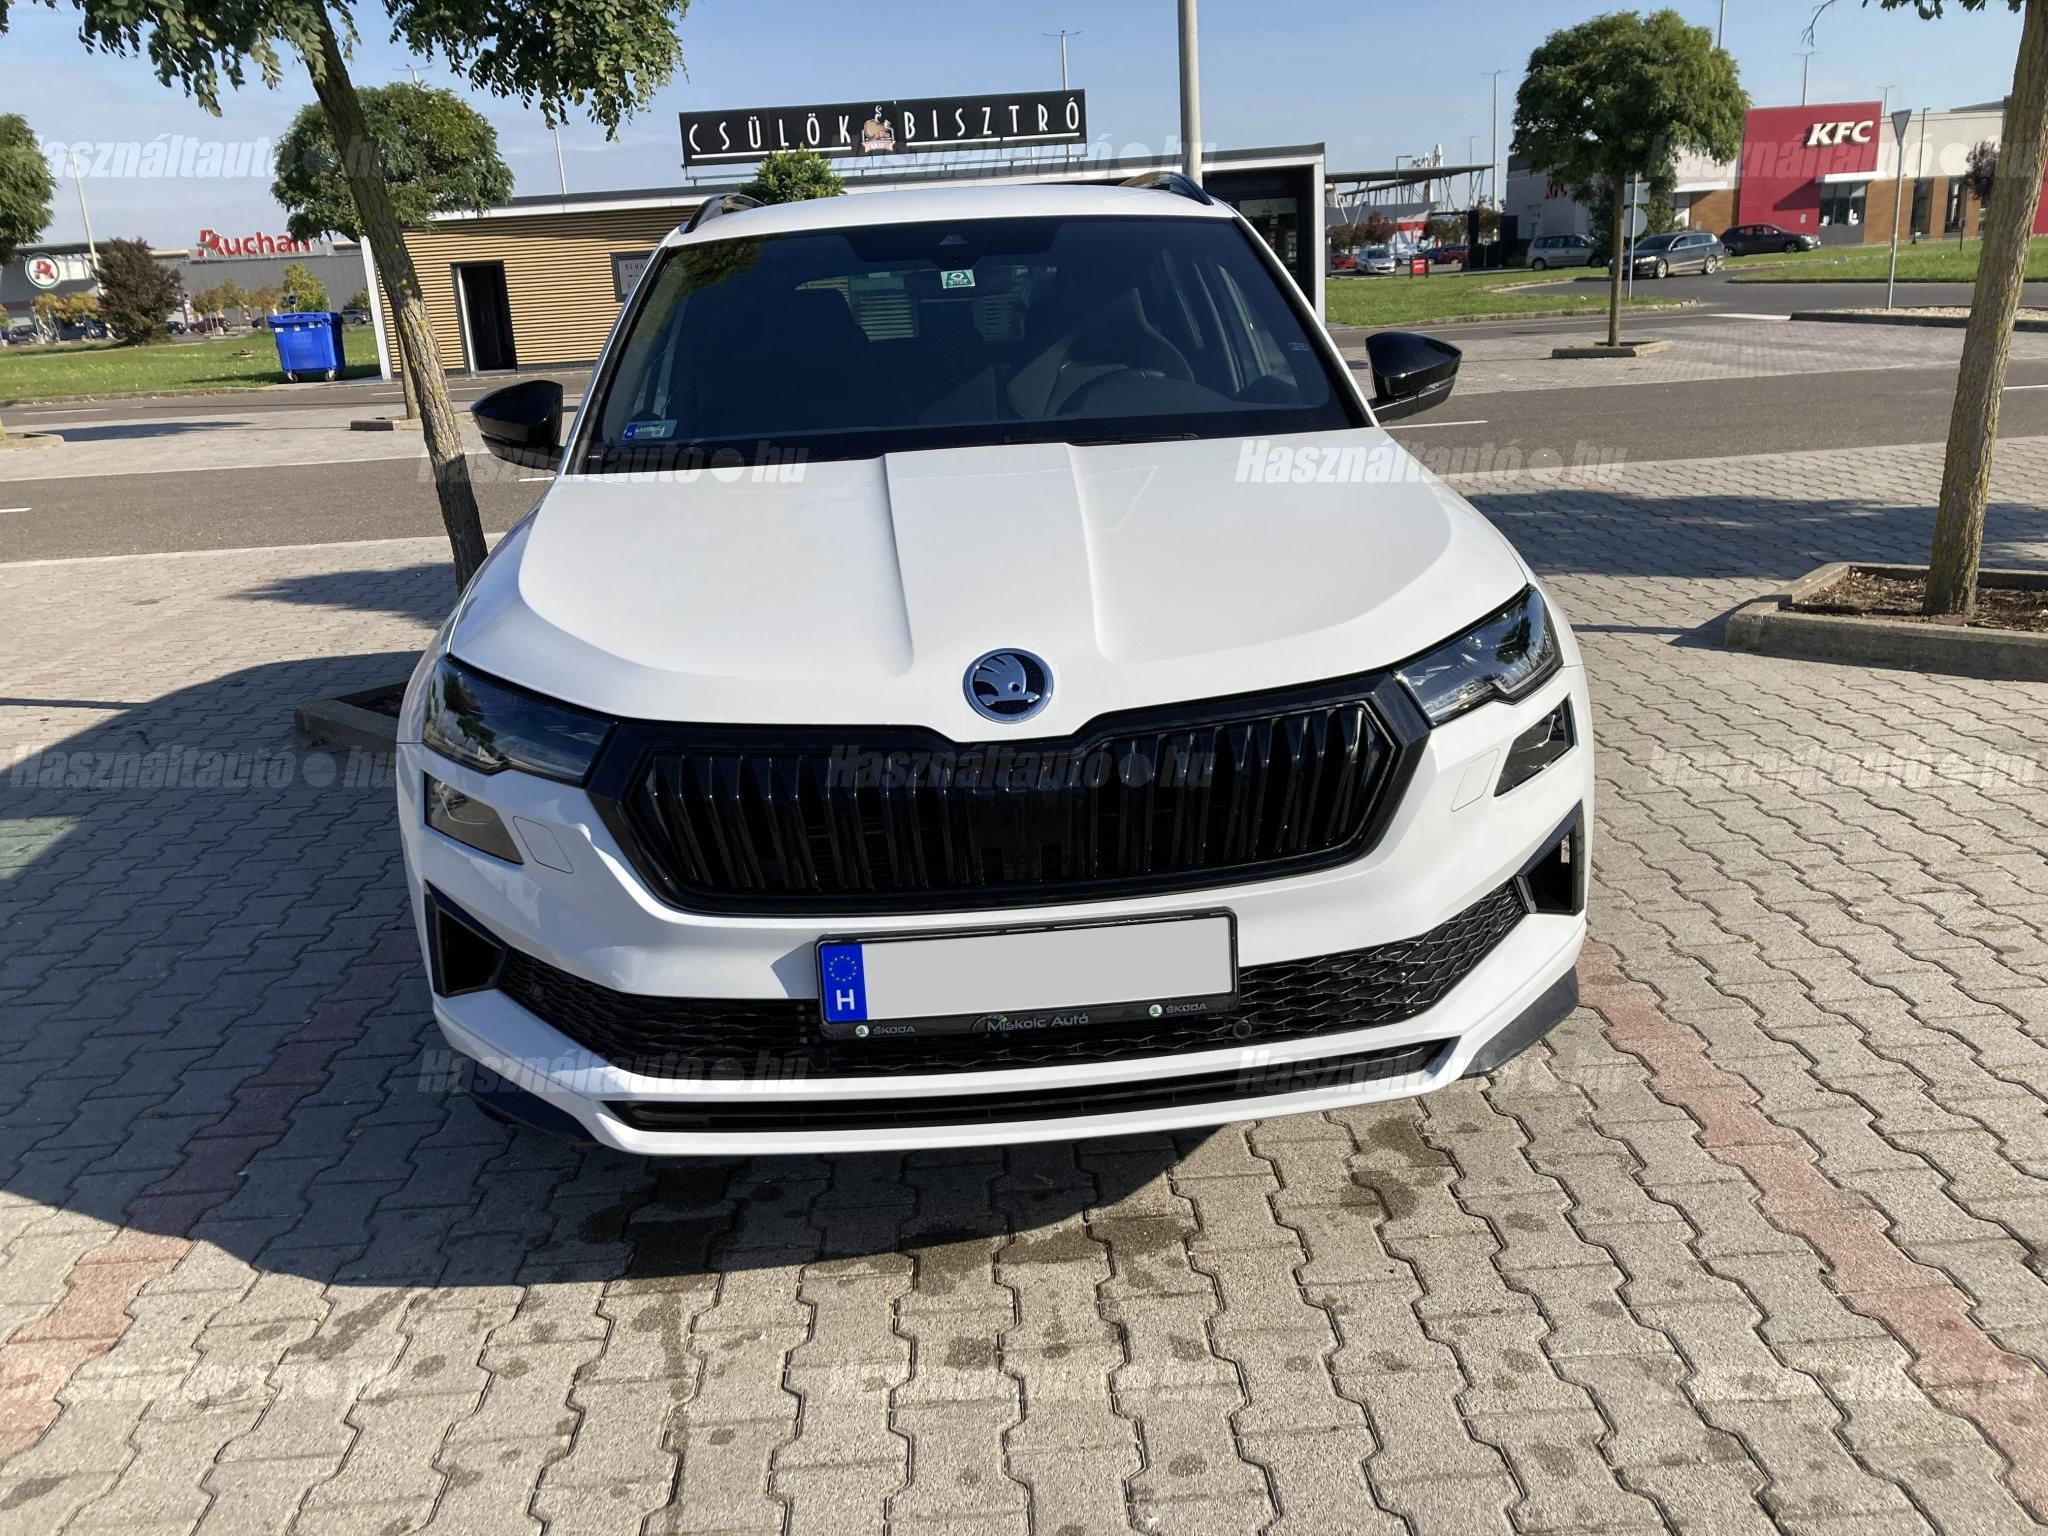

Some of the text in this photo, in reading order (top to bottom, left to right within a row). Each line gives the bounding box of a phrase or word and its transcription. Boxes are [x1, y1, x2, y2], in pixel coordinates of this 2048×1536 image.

[688, 97, 1080, 151] CSÜLÖK BISZTRÓ
[1807, 120, 1874, 145] KFC
[196, 228, 313, 257] Auchan
[836, 989, 855, 1011] H
